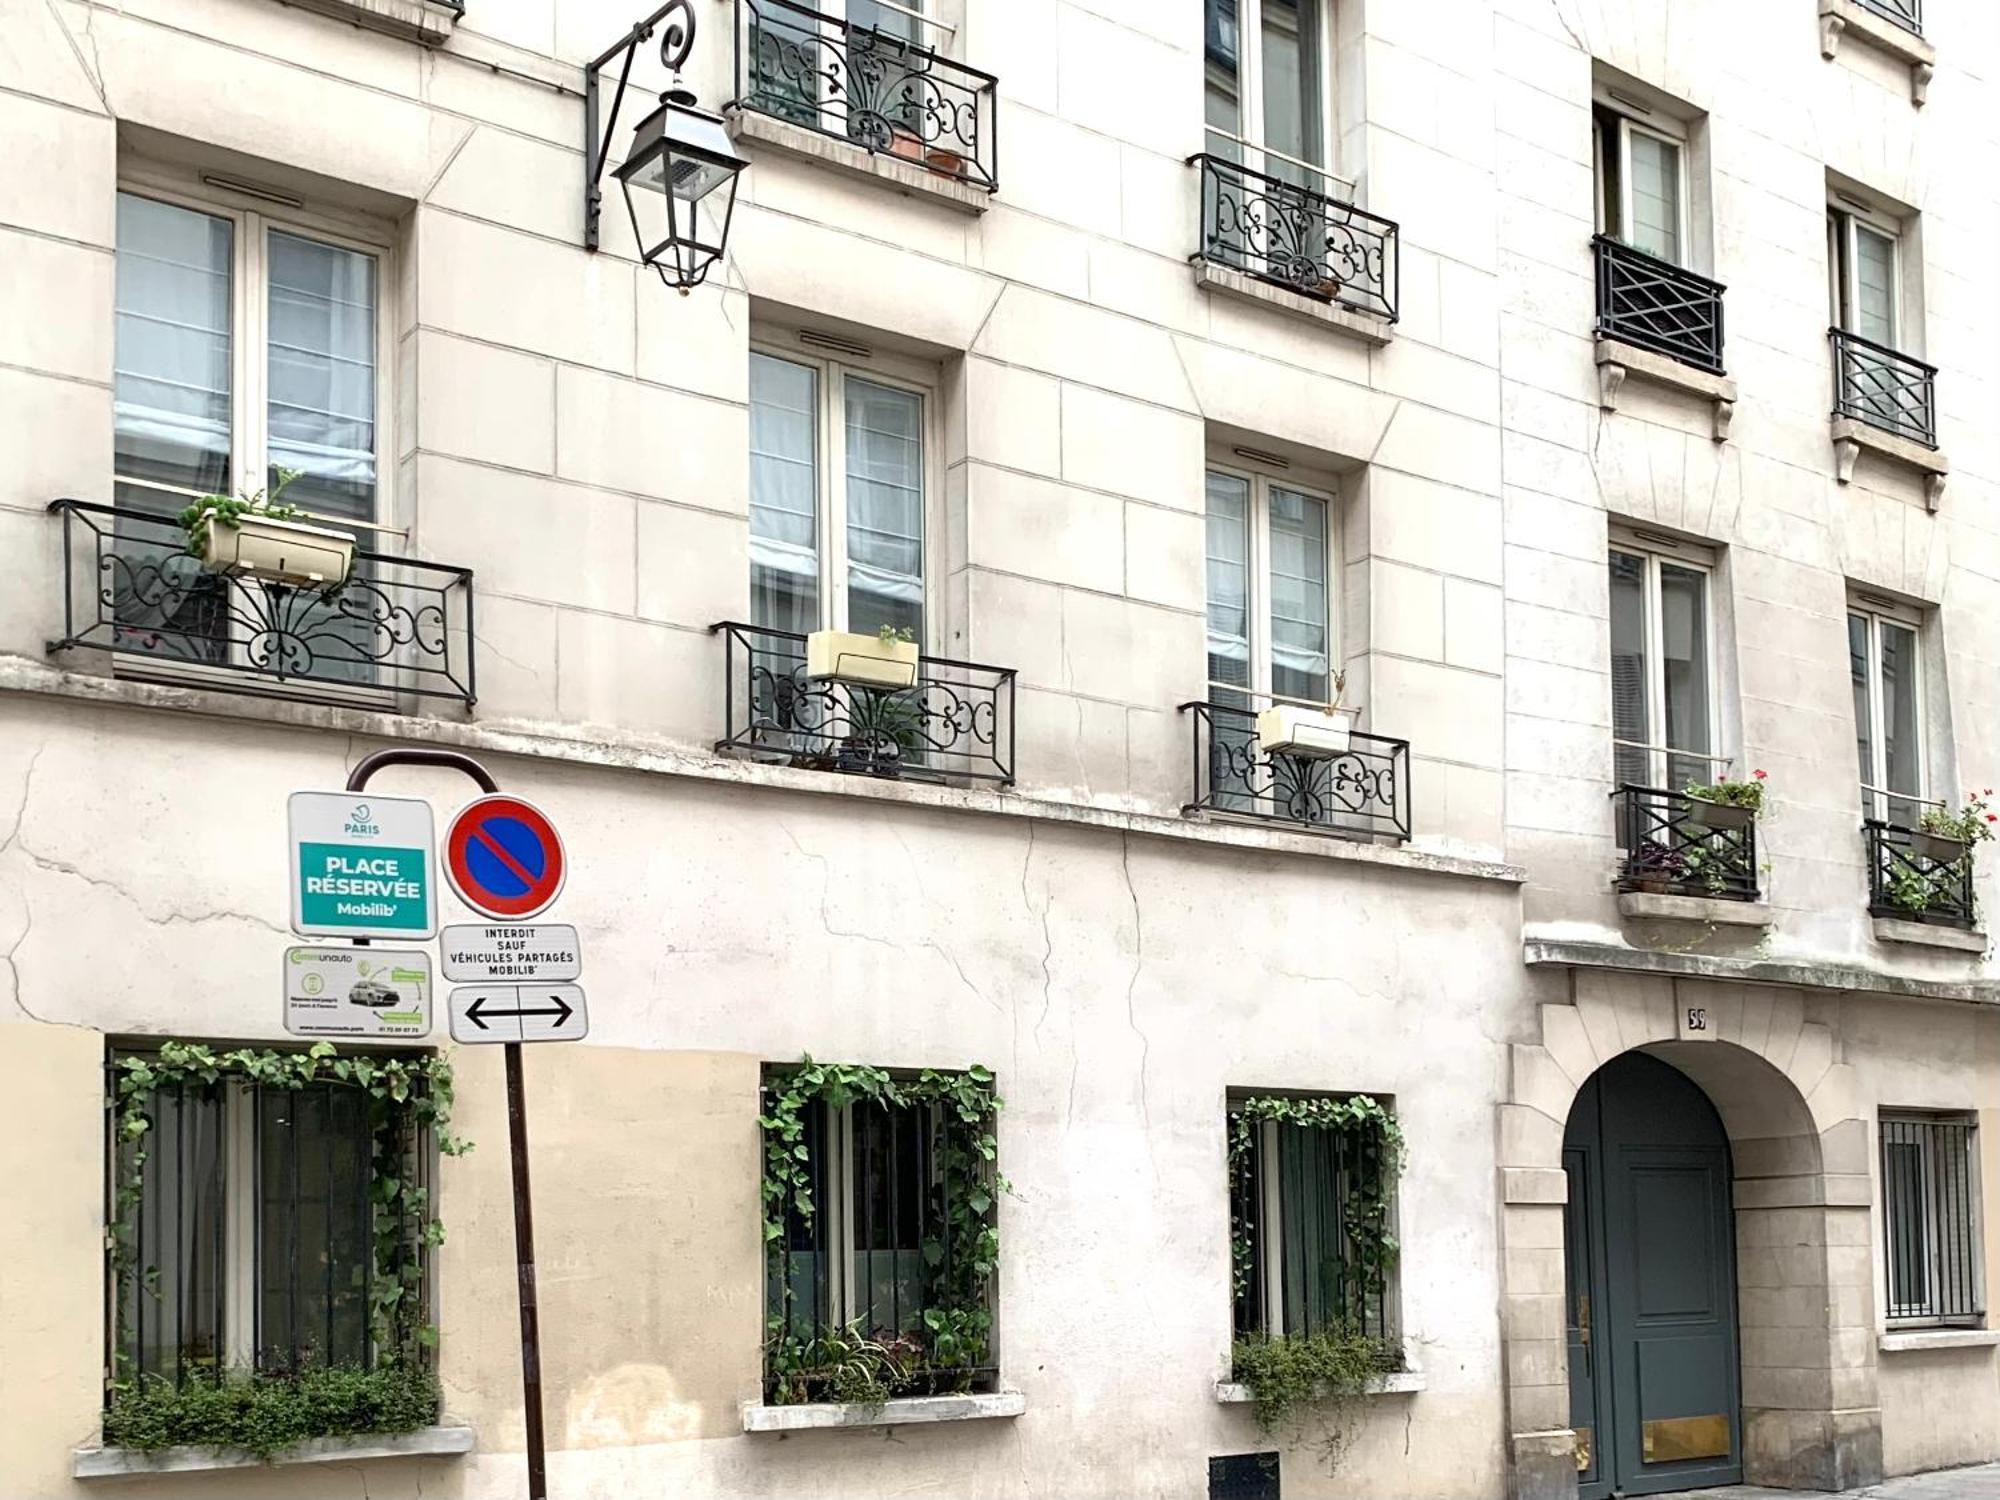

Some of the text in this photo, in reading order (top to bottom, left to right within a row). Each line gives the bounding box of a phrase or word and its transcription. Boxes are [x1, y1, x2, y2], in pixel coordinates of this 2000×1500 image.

[344, 823, 380, 834] PARIS
[326, 856, 399, 876] PLACE
[306, 874, 421, 899] RÉSERVÉE
[337, 902, 397, 917] Mobilib'
[485, 928, 536, 938] INTERDIT
[497, 940, 527, 951] SAUF
[450, 951, 574, 963] VÉHICULES PARTAGÉS
[1688, 1009, 1706, 1030] 59
